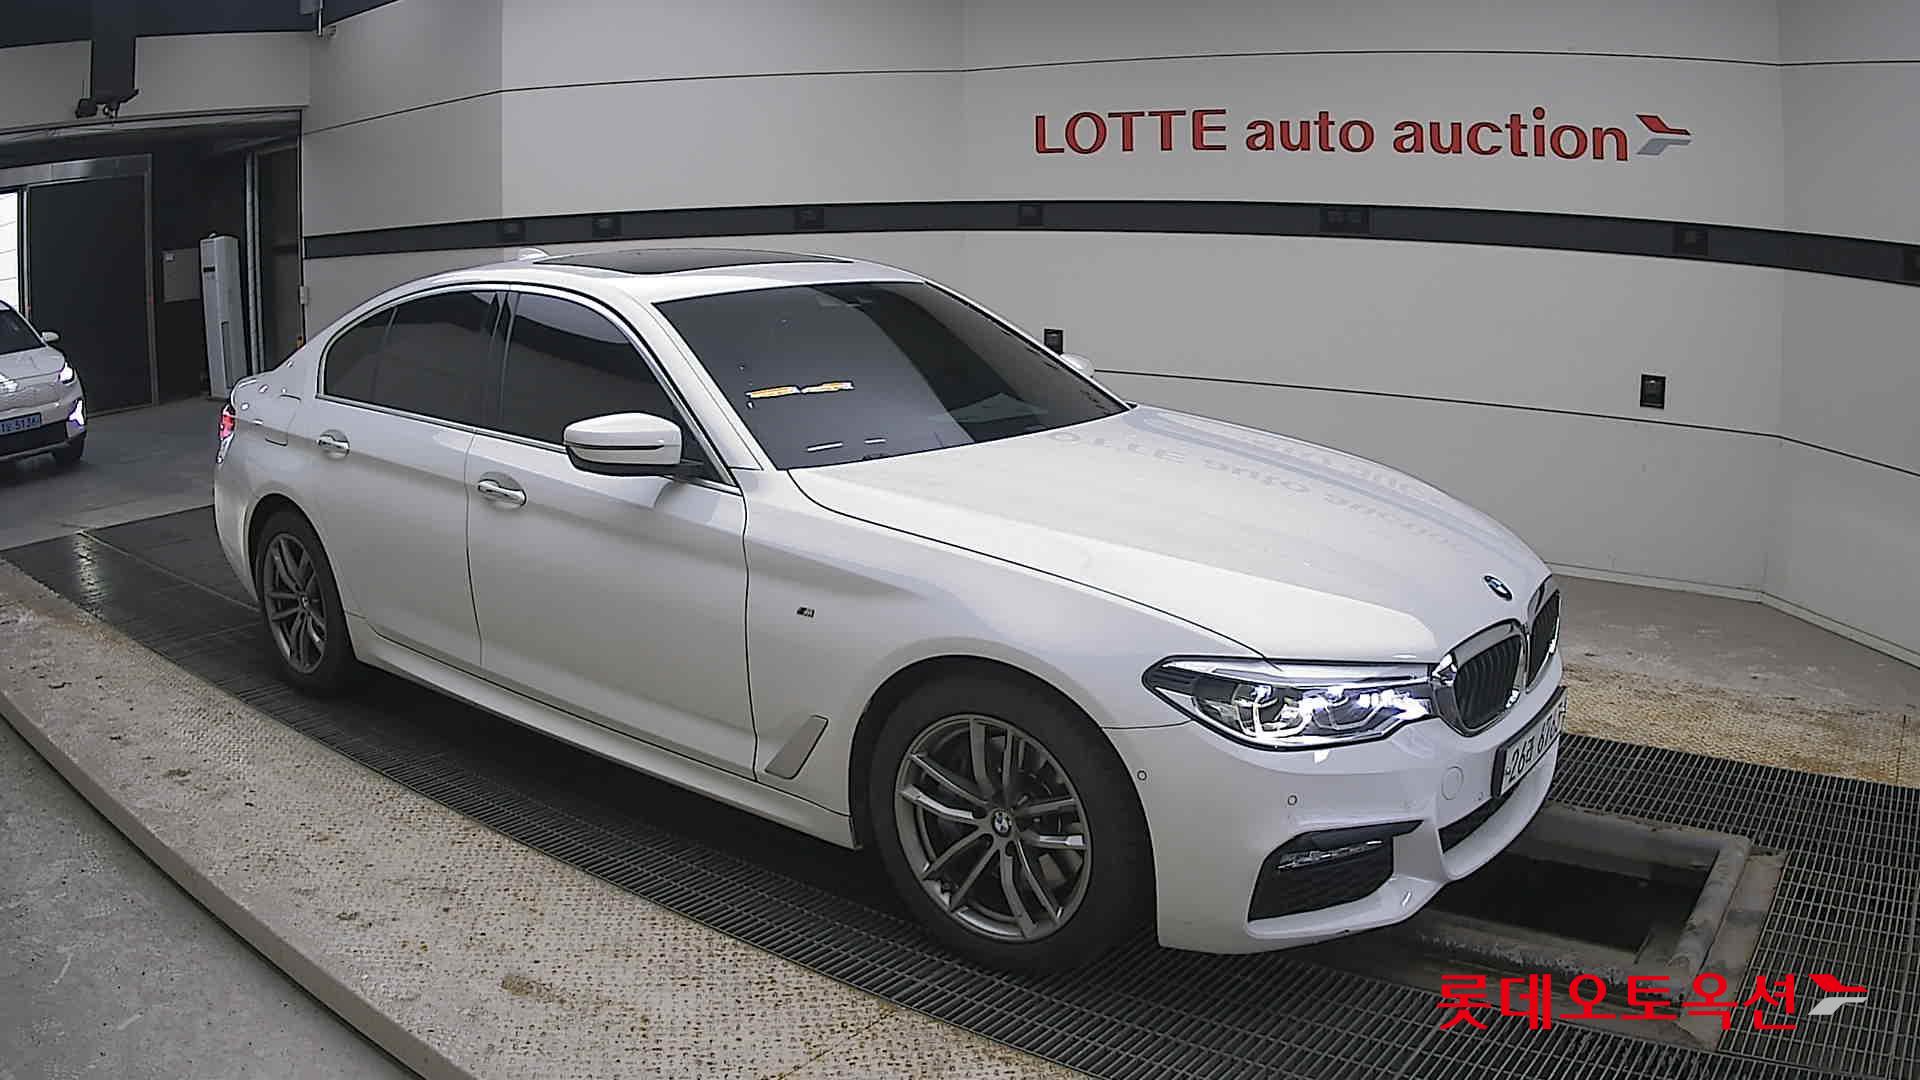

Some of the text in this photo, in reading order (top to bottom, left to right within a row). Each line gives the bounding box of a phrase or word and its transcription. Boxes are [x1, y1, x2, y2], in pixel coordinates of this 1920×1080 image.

[1036, 107, 1628, 161] LOTTE auto auction
